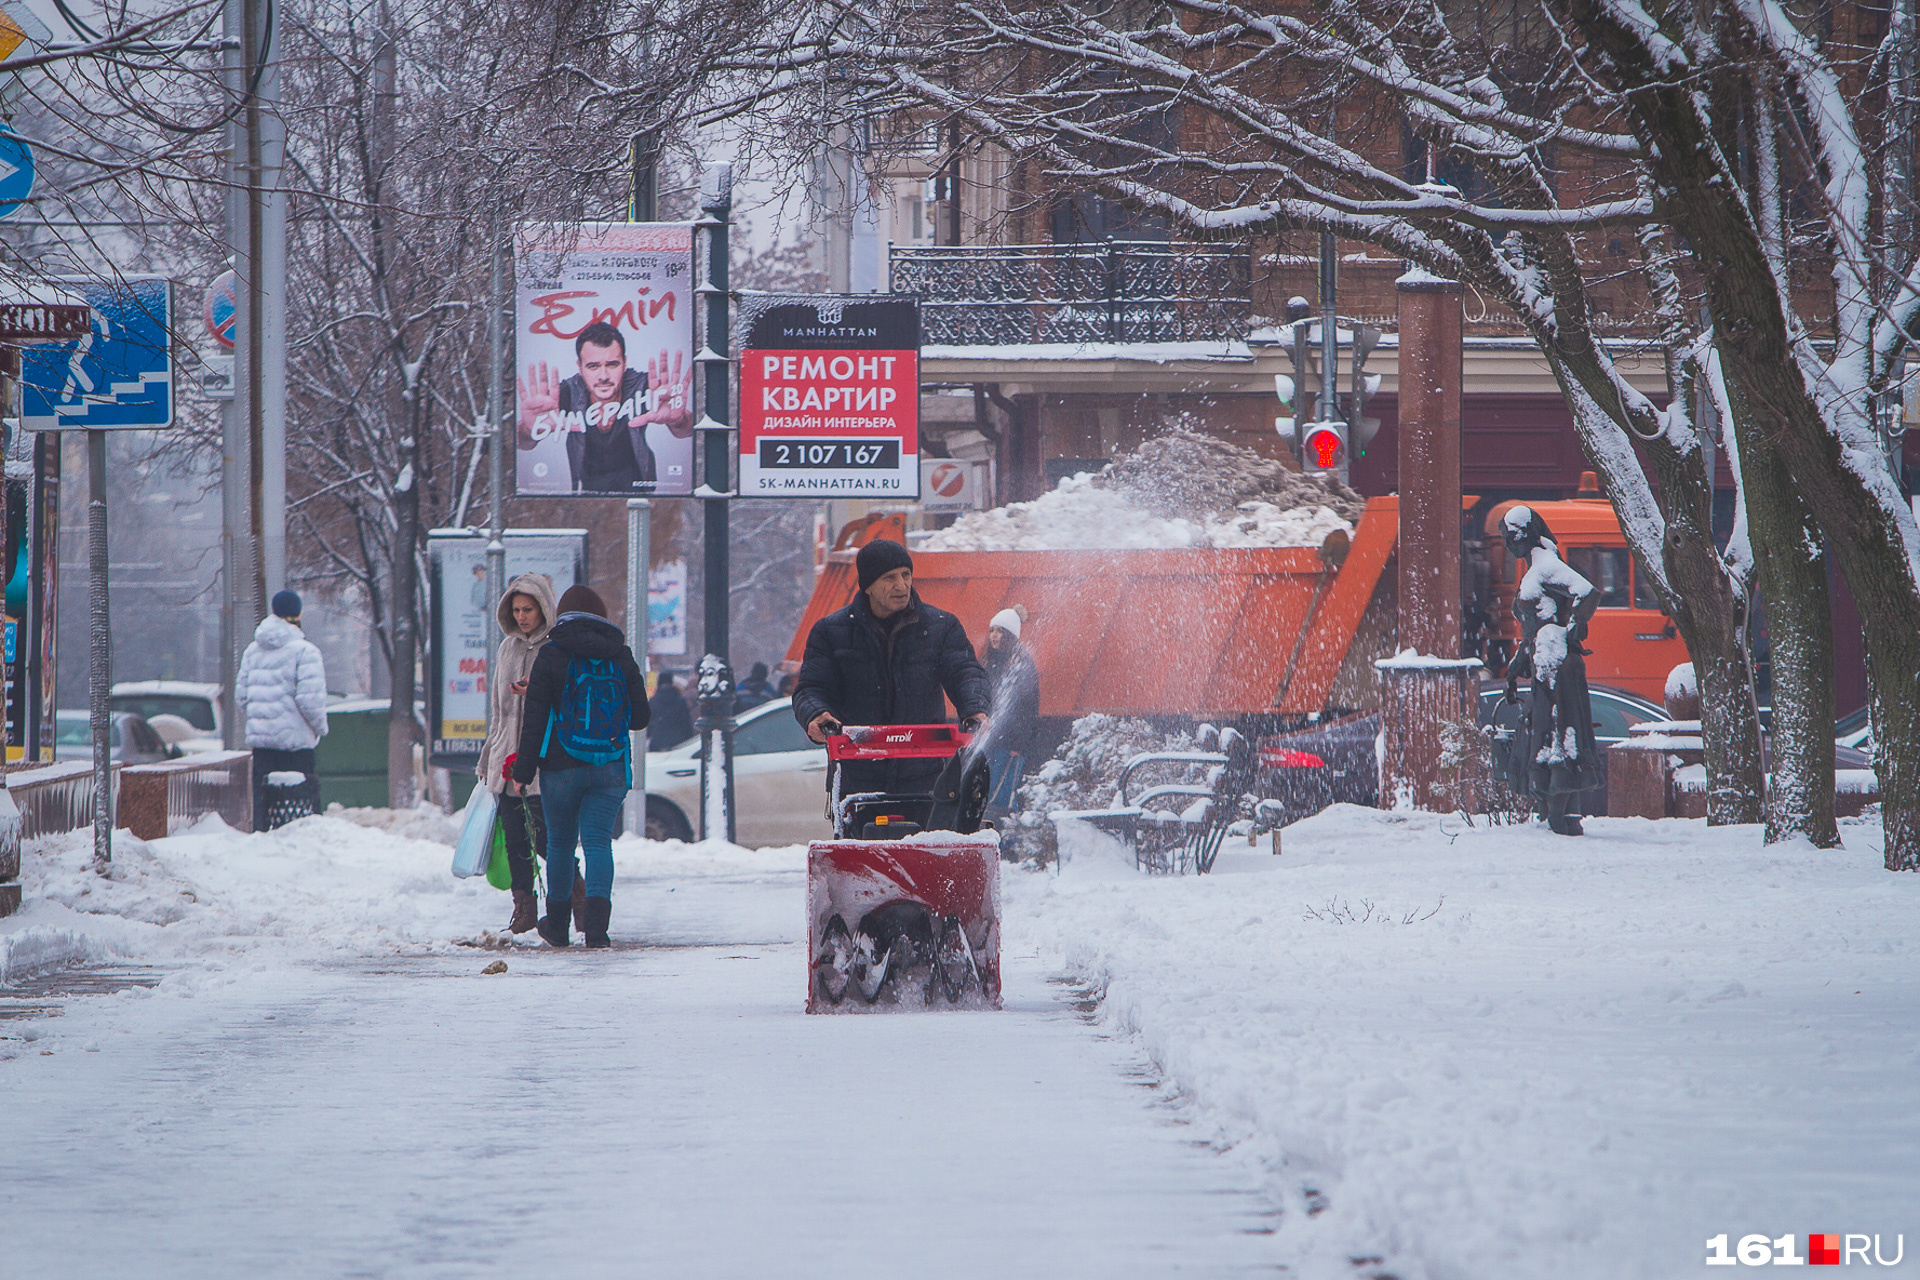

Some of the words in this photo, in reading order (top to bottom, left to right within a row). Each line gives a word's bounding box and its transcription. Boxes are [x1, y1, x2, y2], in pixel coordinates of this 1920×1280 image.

[529, 286, 676, 340] Emin
[783, 327, 878, 337] MANHATTAN
[763, 356, 897, 380] РЕМОНТ
[670, 383, 684, 395] 20
[668, 395, 684, 410] 18
[762, 387, 897, 411] КВАРТИР
[763, 415, 822, 430] ДИЗАЙН
[824, 416, 897, 429] ИНТЕРЬЕРА
[775, 445, 790, 464] 2
[797, 445, 837, 464] 107
[843, 445, 884, 464] 167
[759, 478, 900, 489] SK-MANHATTAN.RU
